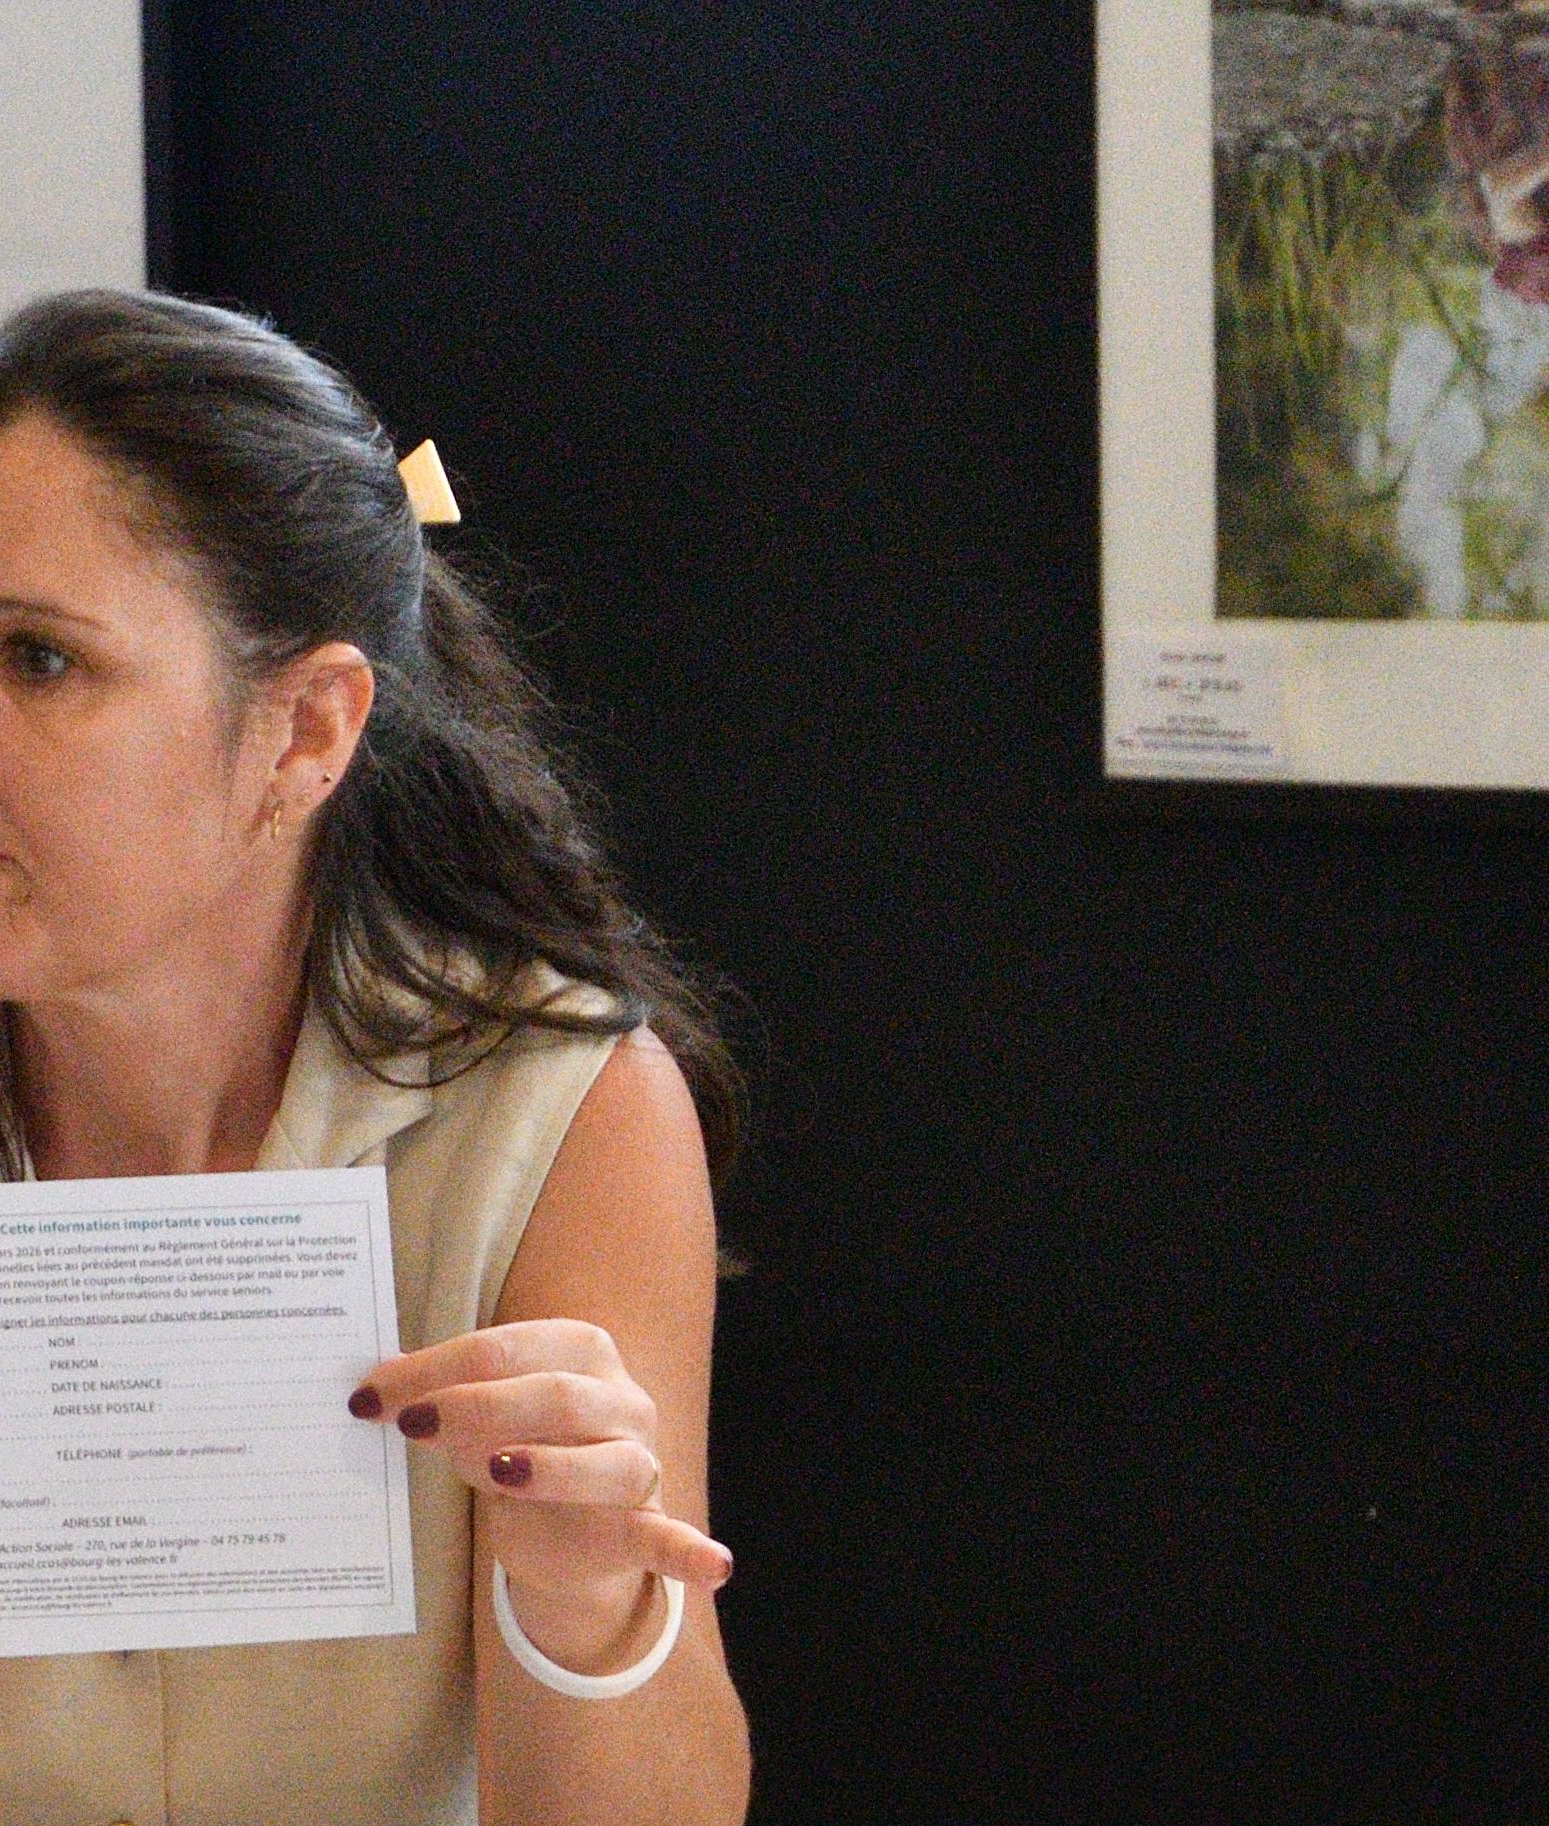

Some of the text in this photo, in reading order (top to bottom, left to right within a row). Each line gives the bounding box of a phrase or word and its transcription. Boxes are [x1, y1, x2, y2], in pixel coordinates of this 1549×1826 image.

[0, 1224, 35, 1235] Cette
[38, 1221, 120, 1233] information
[123, 1217, 201, 1232] importante
[204, 1217, 237, 1227] vous
[239, 1214, 302, 1226] concerne
[220, 1238, 263, 1249] Général
[266, 1239, 283, 1247] sur
[298, 1236, 356, 1246] Protection
[81, 1259, 136, 1272] précédent
[139, 1257, 182, 1267] mandat
[185, 1257, 203, 1266] ont
[206, 1255, 223, 1265] été
[297, 1254, 323, 1262] Vous
[325, 1251, 357, 1261] devez
[13, 1278, 68, 1290] renvoyant
[237, 1272, 254, 1282] par
[258, 1270, 282, 1279] mail
[301, 1270, 318, 1279] par
[322, 1269, 345, 1277] voie
[45, 1294, 80, 1303] toutes
[82, 1292, 97, 1301] les
[100, 1290, 171, 1300] informations
[191, 1289, 229, 1297] service
[48, 1337, 75, 1348] NOM
[49, 1359, 98, 1370] PRENOM
[51, 1382, 78, 1393] DATE
[100, 1379, 162, 1390] NAISSANCE
[53, 1402, 154, 1416] ADRESSE POSTALE
[56, 1448, 121, 1461] TÉLÉPHONE
[62, 1516, 147, 1529] ADRESSE EMAIL
